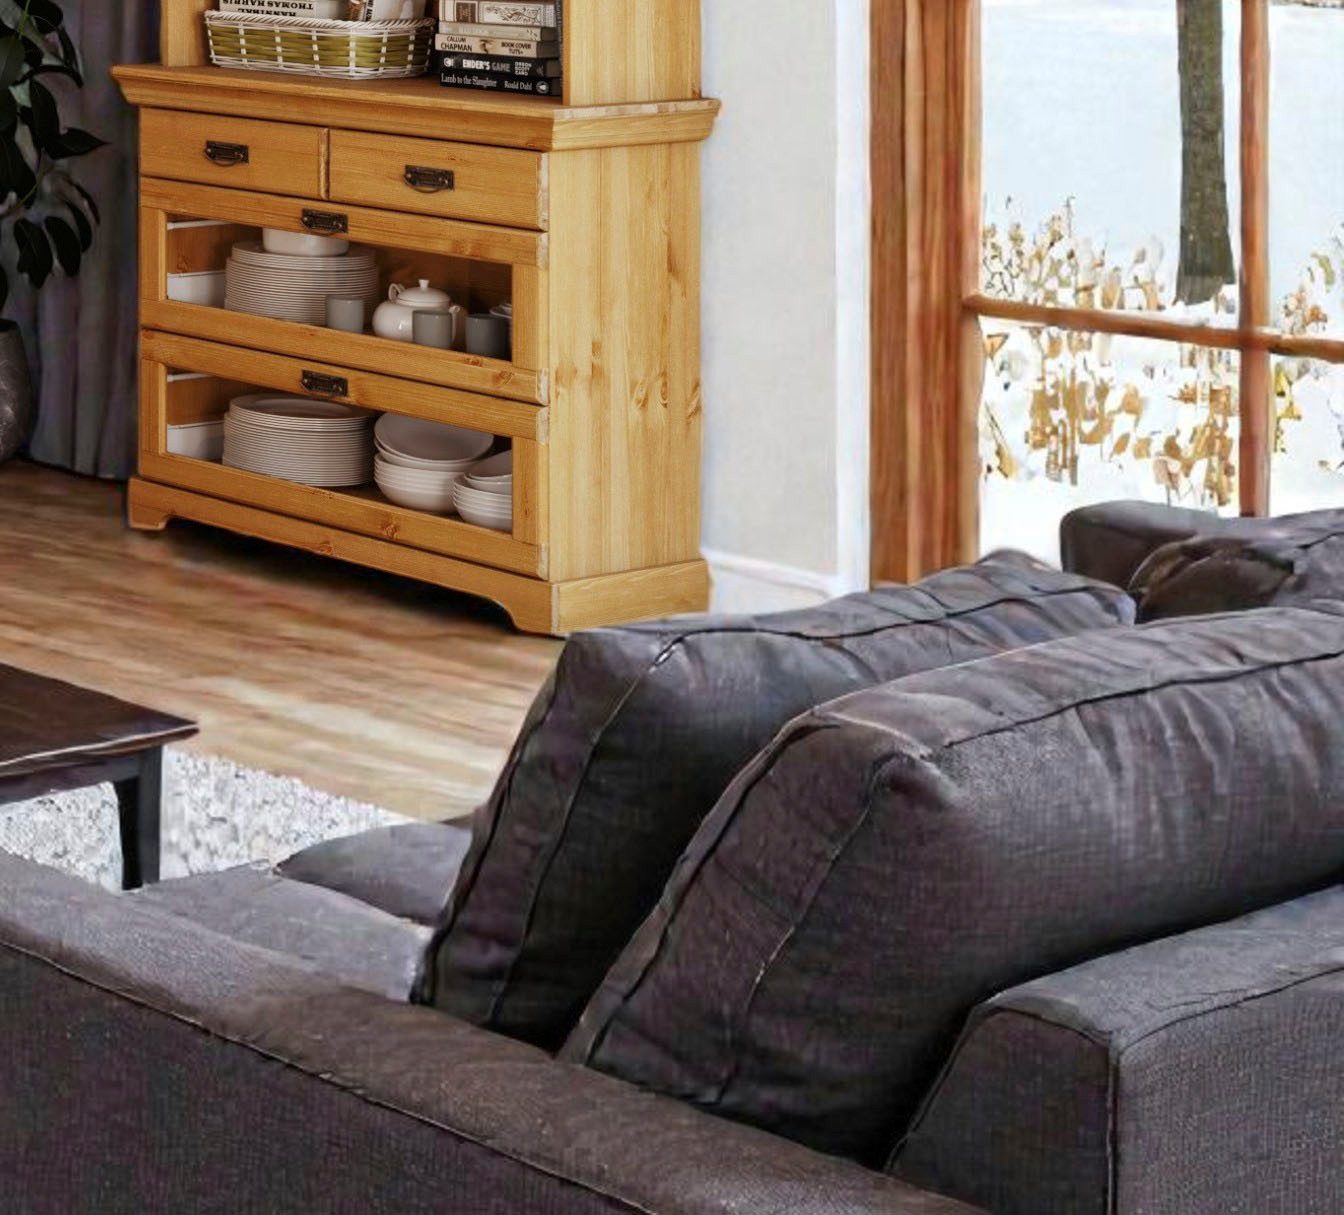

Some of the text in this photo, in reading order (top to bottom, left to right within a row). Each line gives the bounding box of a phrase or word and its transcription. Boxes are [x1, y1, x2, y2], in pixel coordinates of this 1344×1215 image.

[267, 1, 314, 10] THOMAS
[441, 42, 473, 52] CHAPMAN
[462, 59, 511, 73] ENDER'S GAME
[441, 73, 456, 83] Lamb
[472, 75, 497, 88] Slaughter
[505, 80, 518, 90] Roald
[519, 81, 532, 91] Dahl
